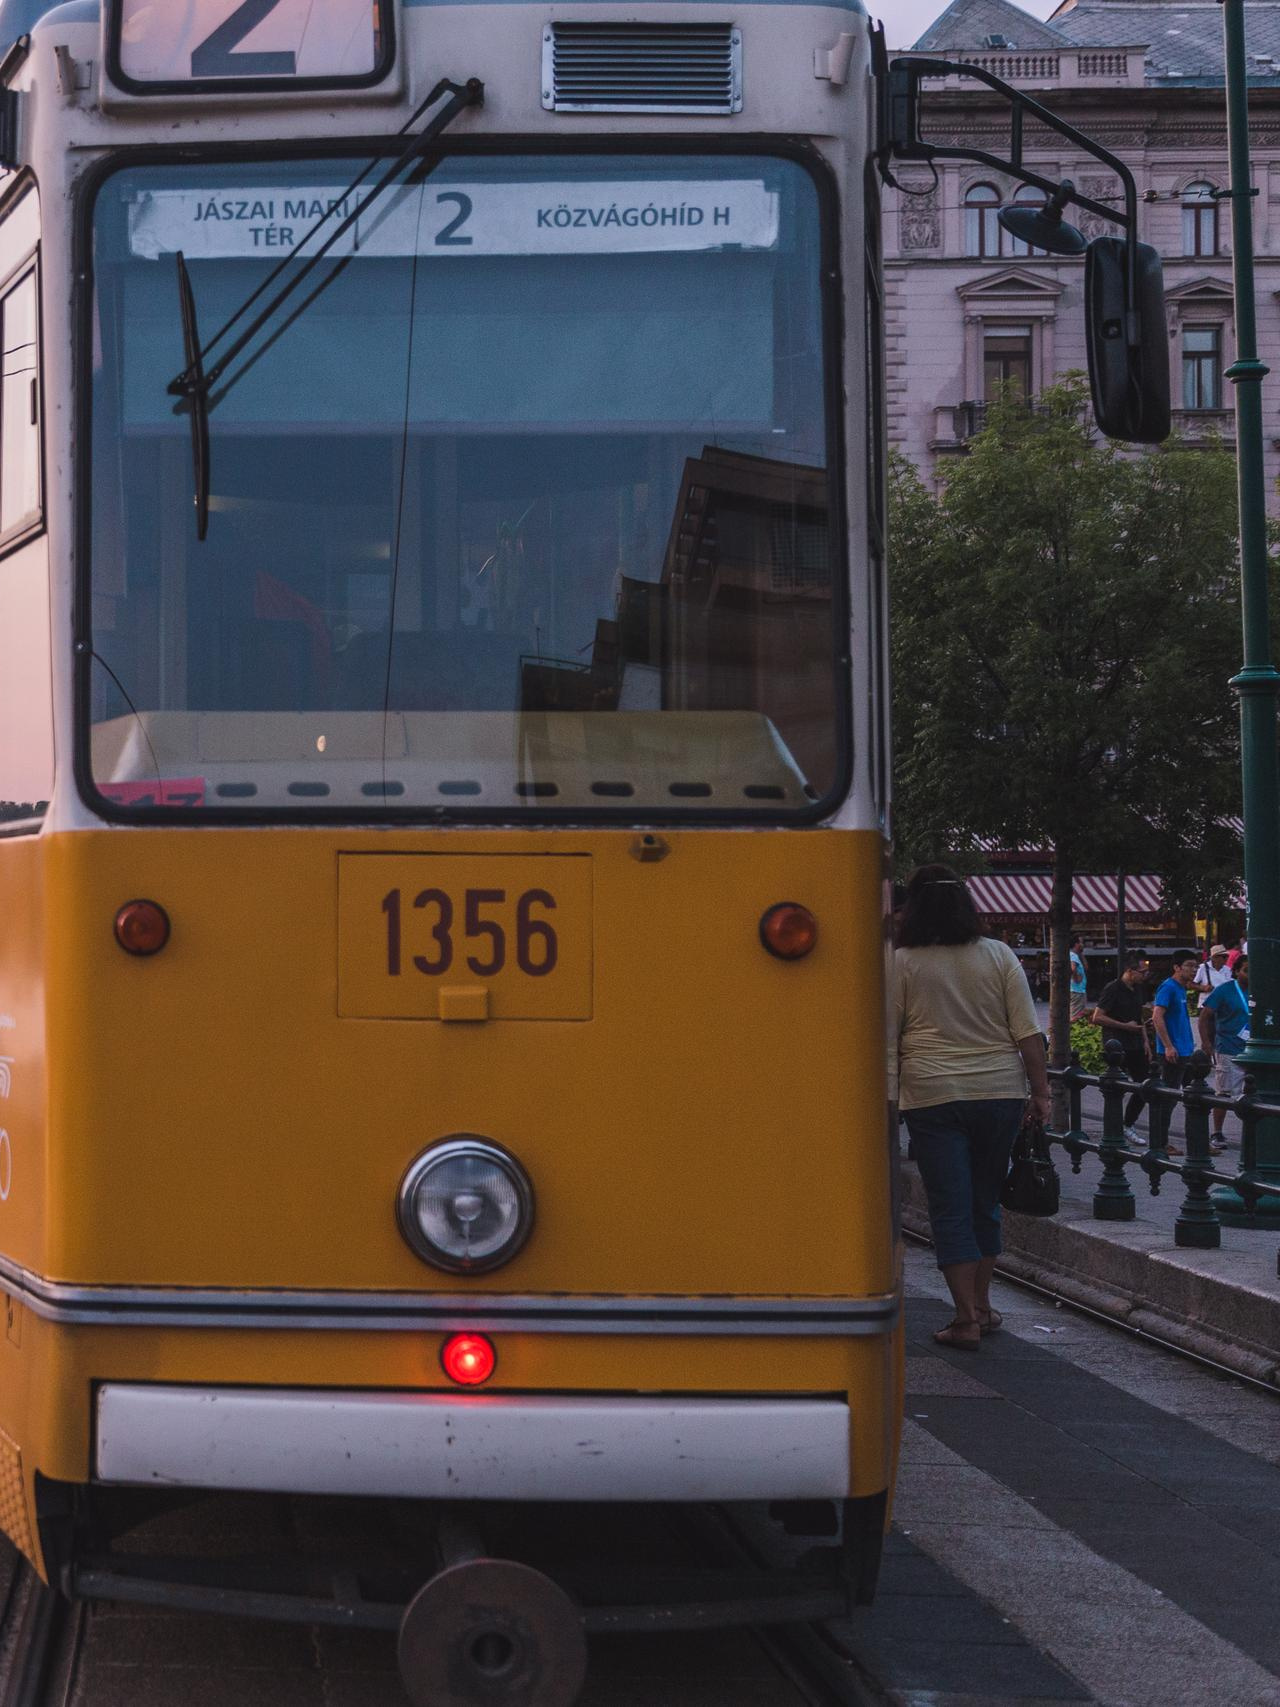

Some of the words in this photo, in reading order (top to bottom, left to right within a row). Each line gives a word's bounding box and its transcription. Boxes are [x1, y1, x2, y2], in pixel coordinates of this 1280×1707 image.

[194, 197, 275, 222] JÁSZAI
[284, 199, 349, 220] MARI
[434, 191, 474, 246] 2
[536, 201, 705, 228] KÖZVÁGÓHÍD
[713, 206, 731, 226] H
[249, 222, 295, 247] TÉR
[381, 887, 559, 977] 1356
